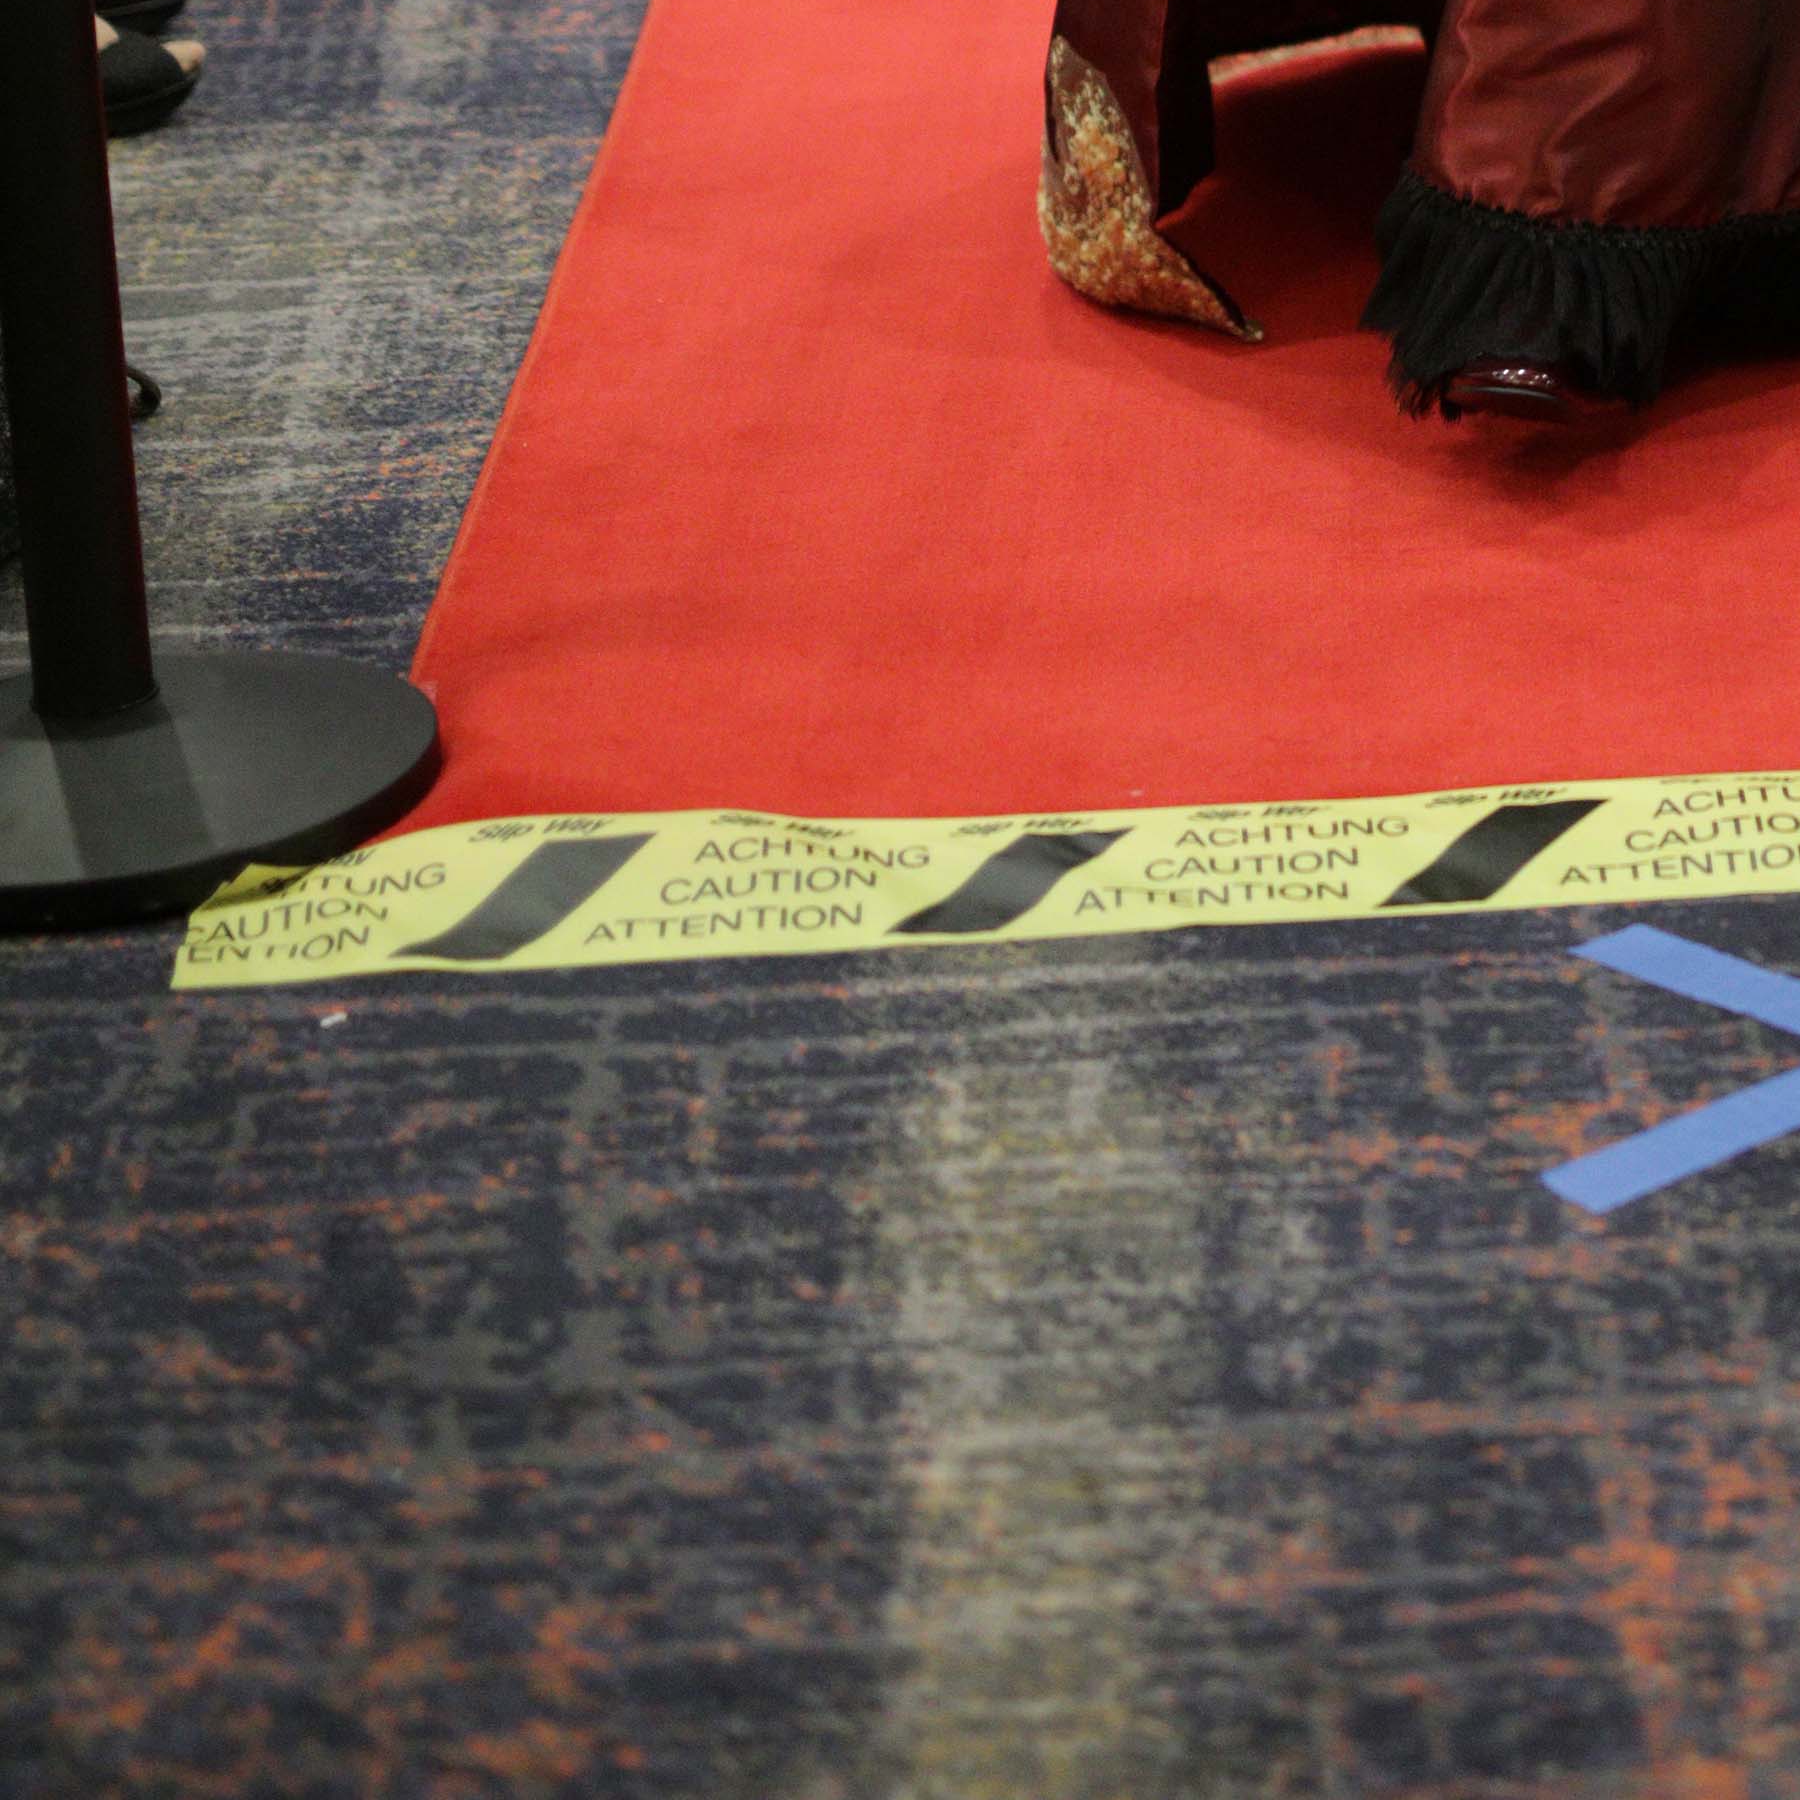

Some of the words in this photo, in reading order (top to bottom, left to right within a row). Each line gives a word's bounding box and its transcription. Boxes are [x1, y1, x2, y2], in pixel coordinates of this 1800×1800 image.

[468, 822, 533, 843] Slip
[542, 817, 617, 836] Way
[1175, 815, 1409, 849] ACHTUNG
[694, 837, 931, 869] ACHTUNG
[1144, 847, 1361, 882] CAUTION
[660, 867, 877, 906] CAUTION
[1074, 881, 1350, 917] ATTENTION
[584, 903, 863, 944] ATTENTION
